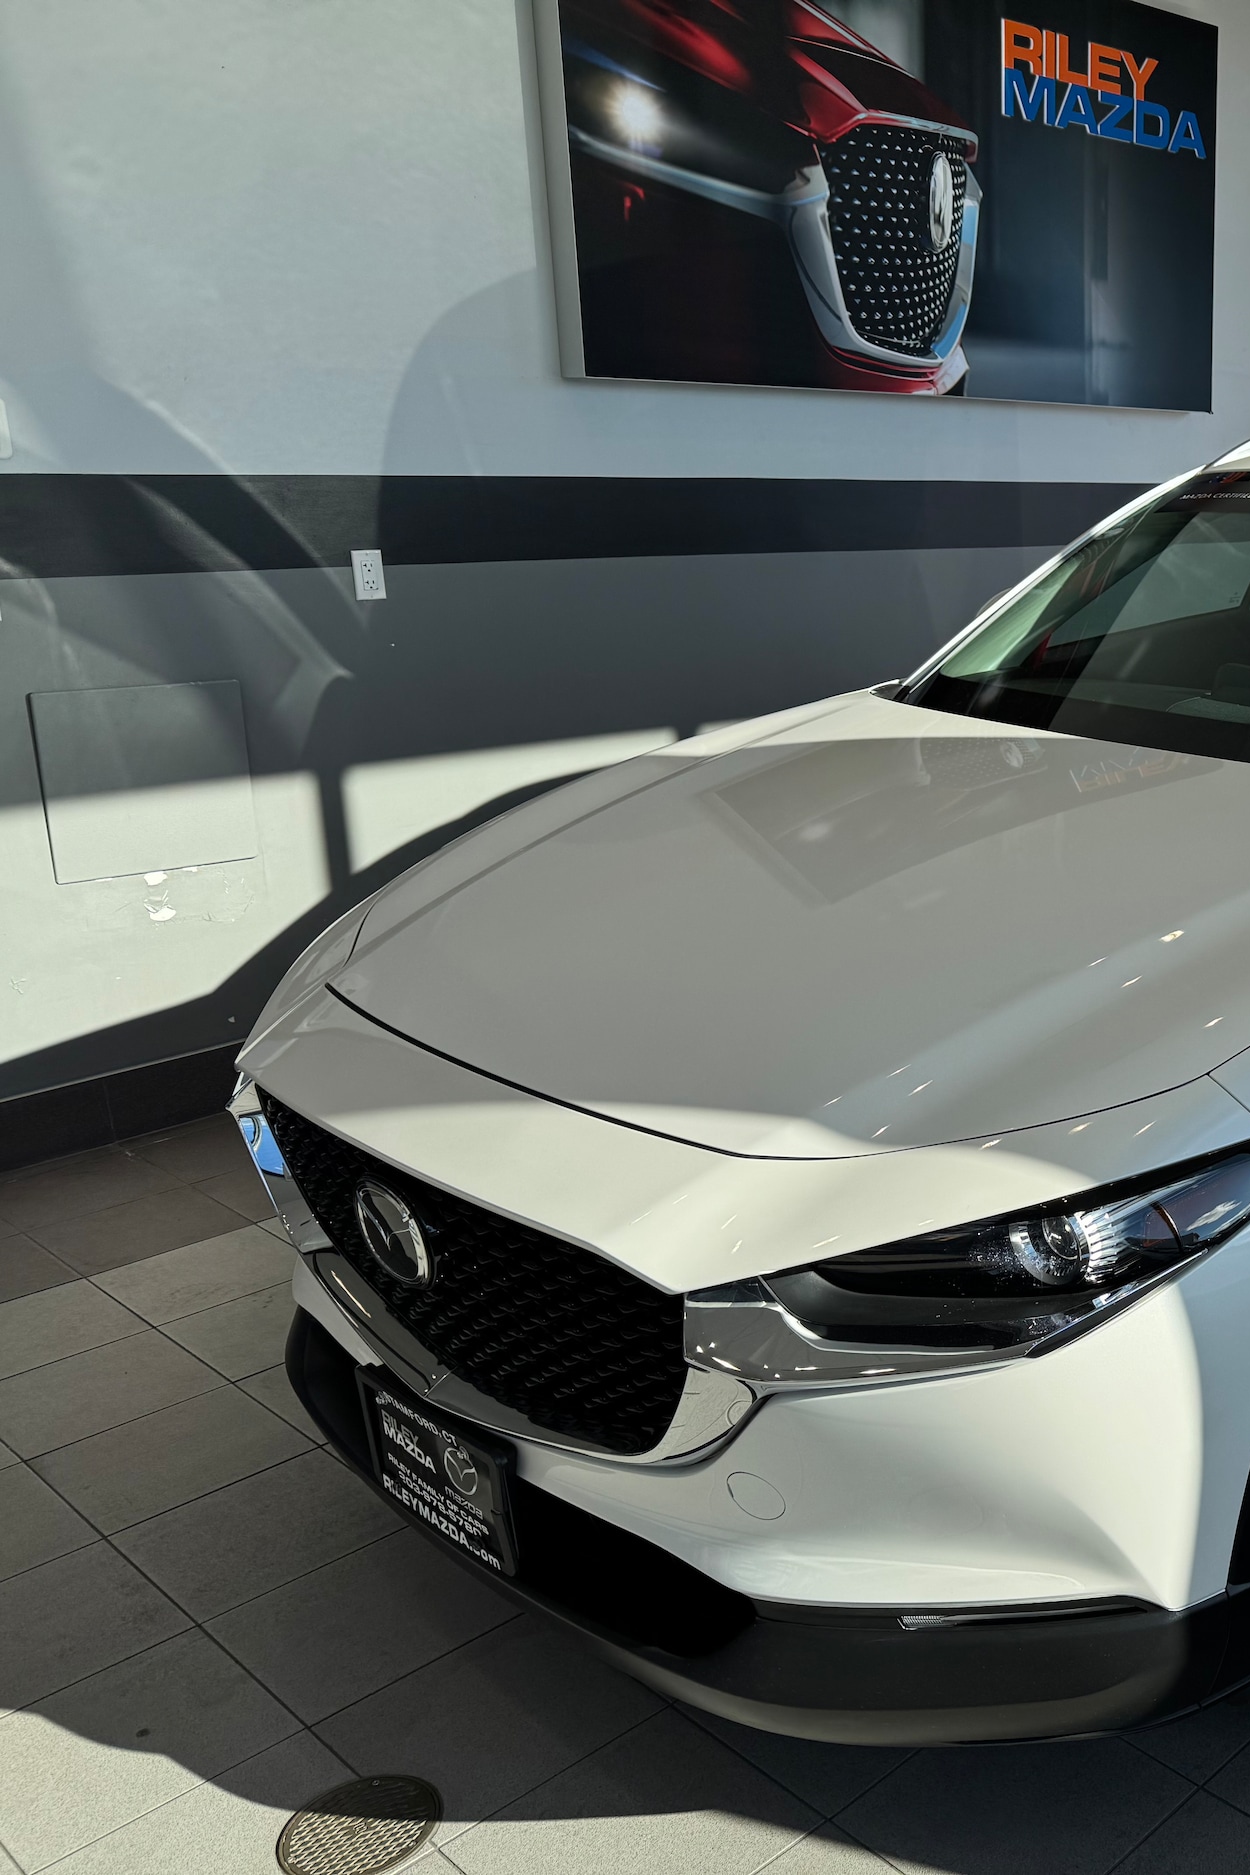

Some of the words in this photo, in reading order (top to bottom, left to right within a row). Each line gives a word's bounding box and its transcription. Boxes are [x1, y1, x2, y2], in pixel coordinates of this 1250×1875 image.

[1001, 18, 1159, 101] RILEY
[1001, 67, 1207, 160] MAZDA
[1179, 492, 1212, 500] MAZDA
[381, 1408, 419, 1446] RILEY
[383, 1421, 437, 1474] MAZDA
[411, 1472, 445, 1503] FAMILY
[445, 1499, 460, 1513] OF
[460, 1509, 490, 1536] CARS
